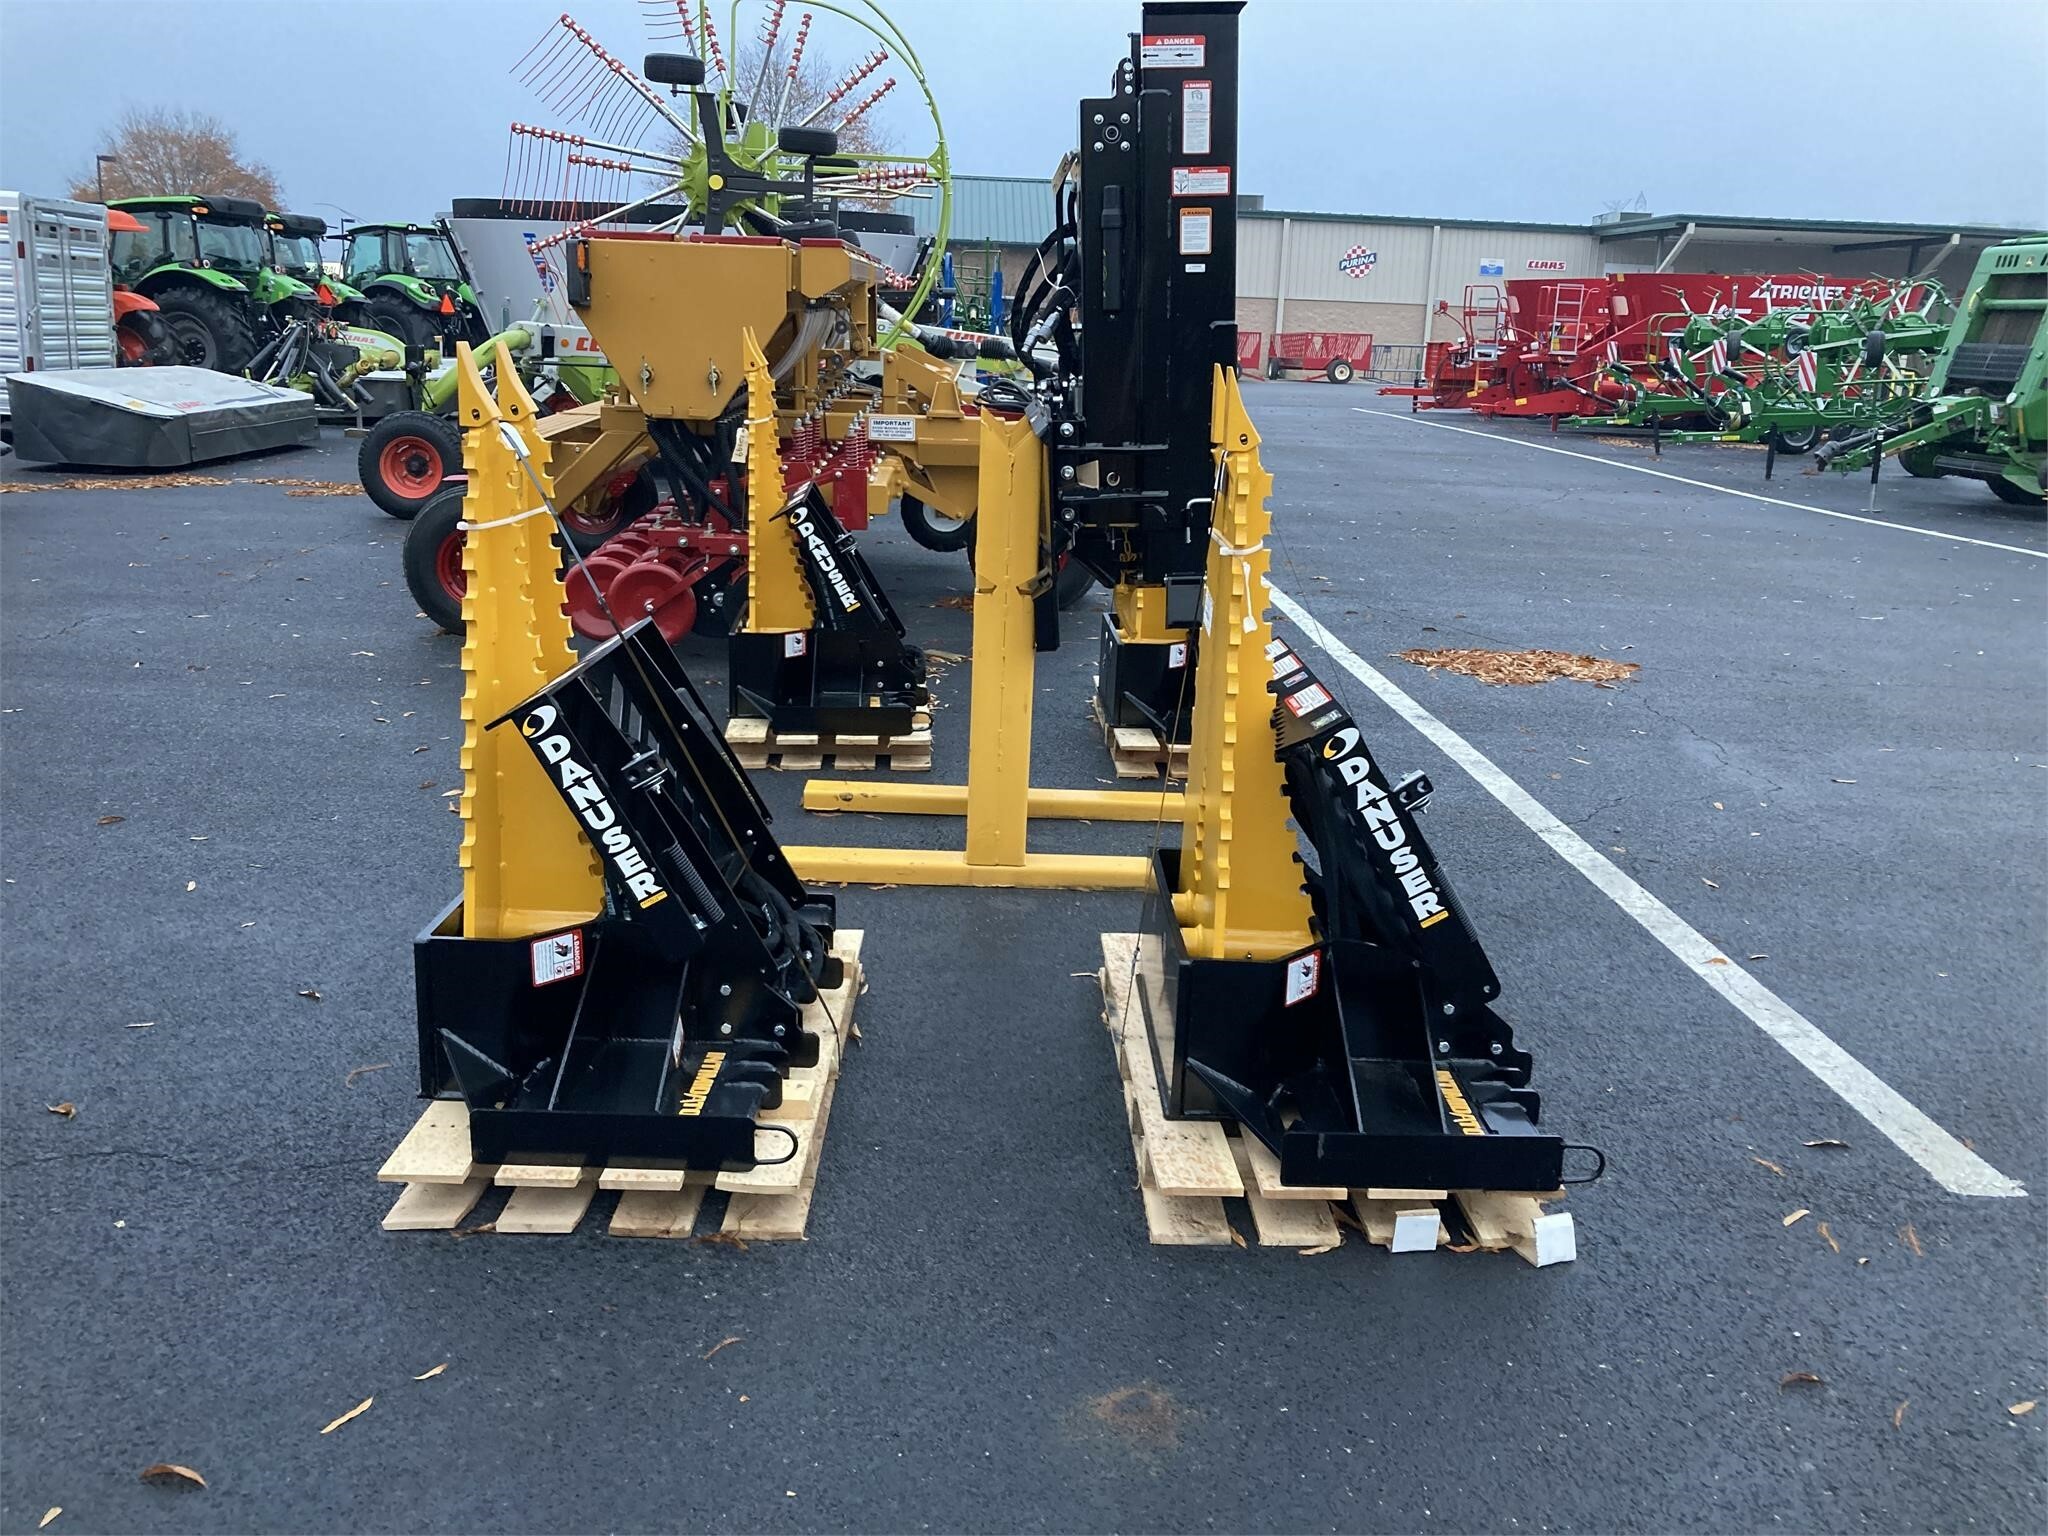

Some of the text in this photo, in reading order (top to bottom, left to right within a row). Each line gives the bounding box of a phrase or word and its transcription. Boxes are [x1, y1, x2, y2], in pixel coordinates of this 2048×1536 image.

[1341, 255, 1376, 270] PURINA
[1528, 261, 1565, 270] CLAAS
[346, 334, 376, 344] LAAS
[798, 522, 859, 609] DANUSER
[538, 734, 663, 901] DANUSER
[1337, 756, 1445, 921] DANUSER
[679, 1052, 726, 1116] INTIMIDATO
